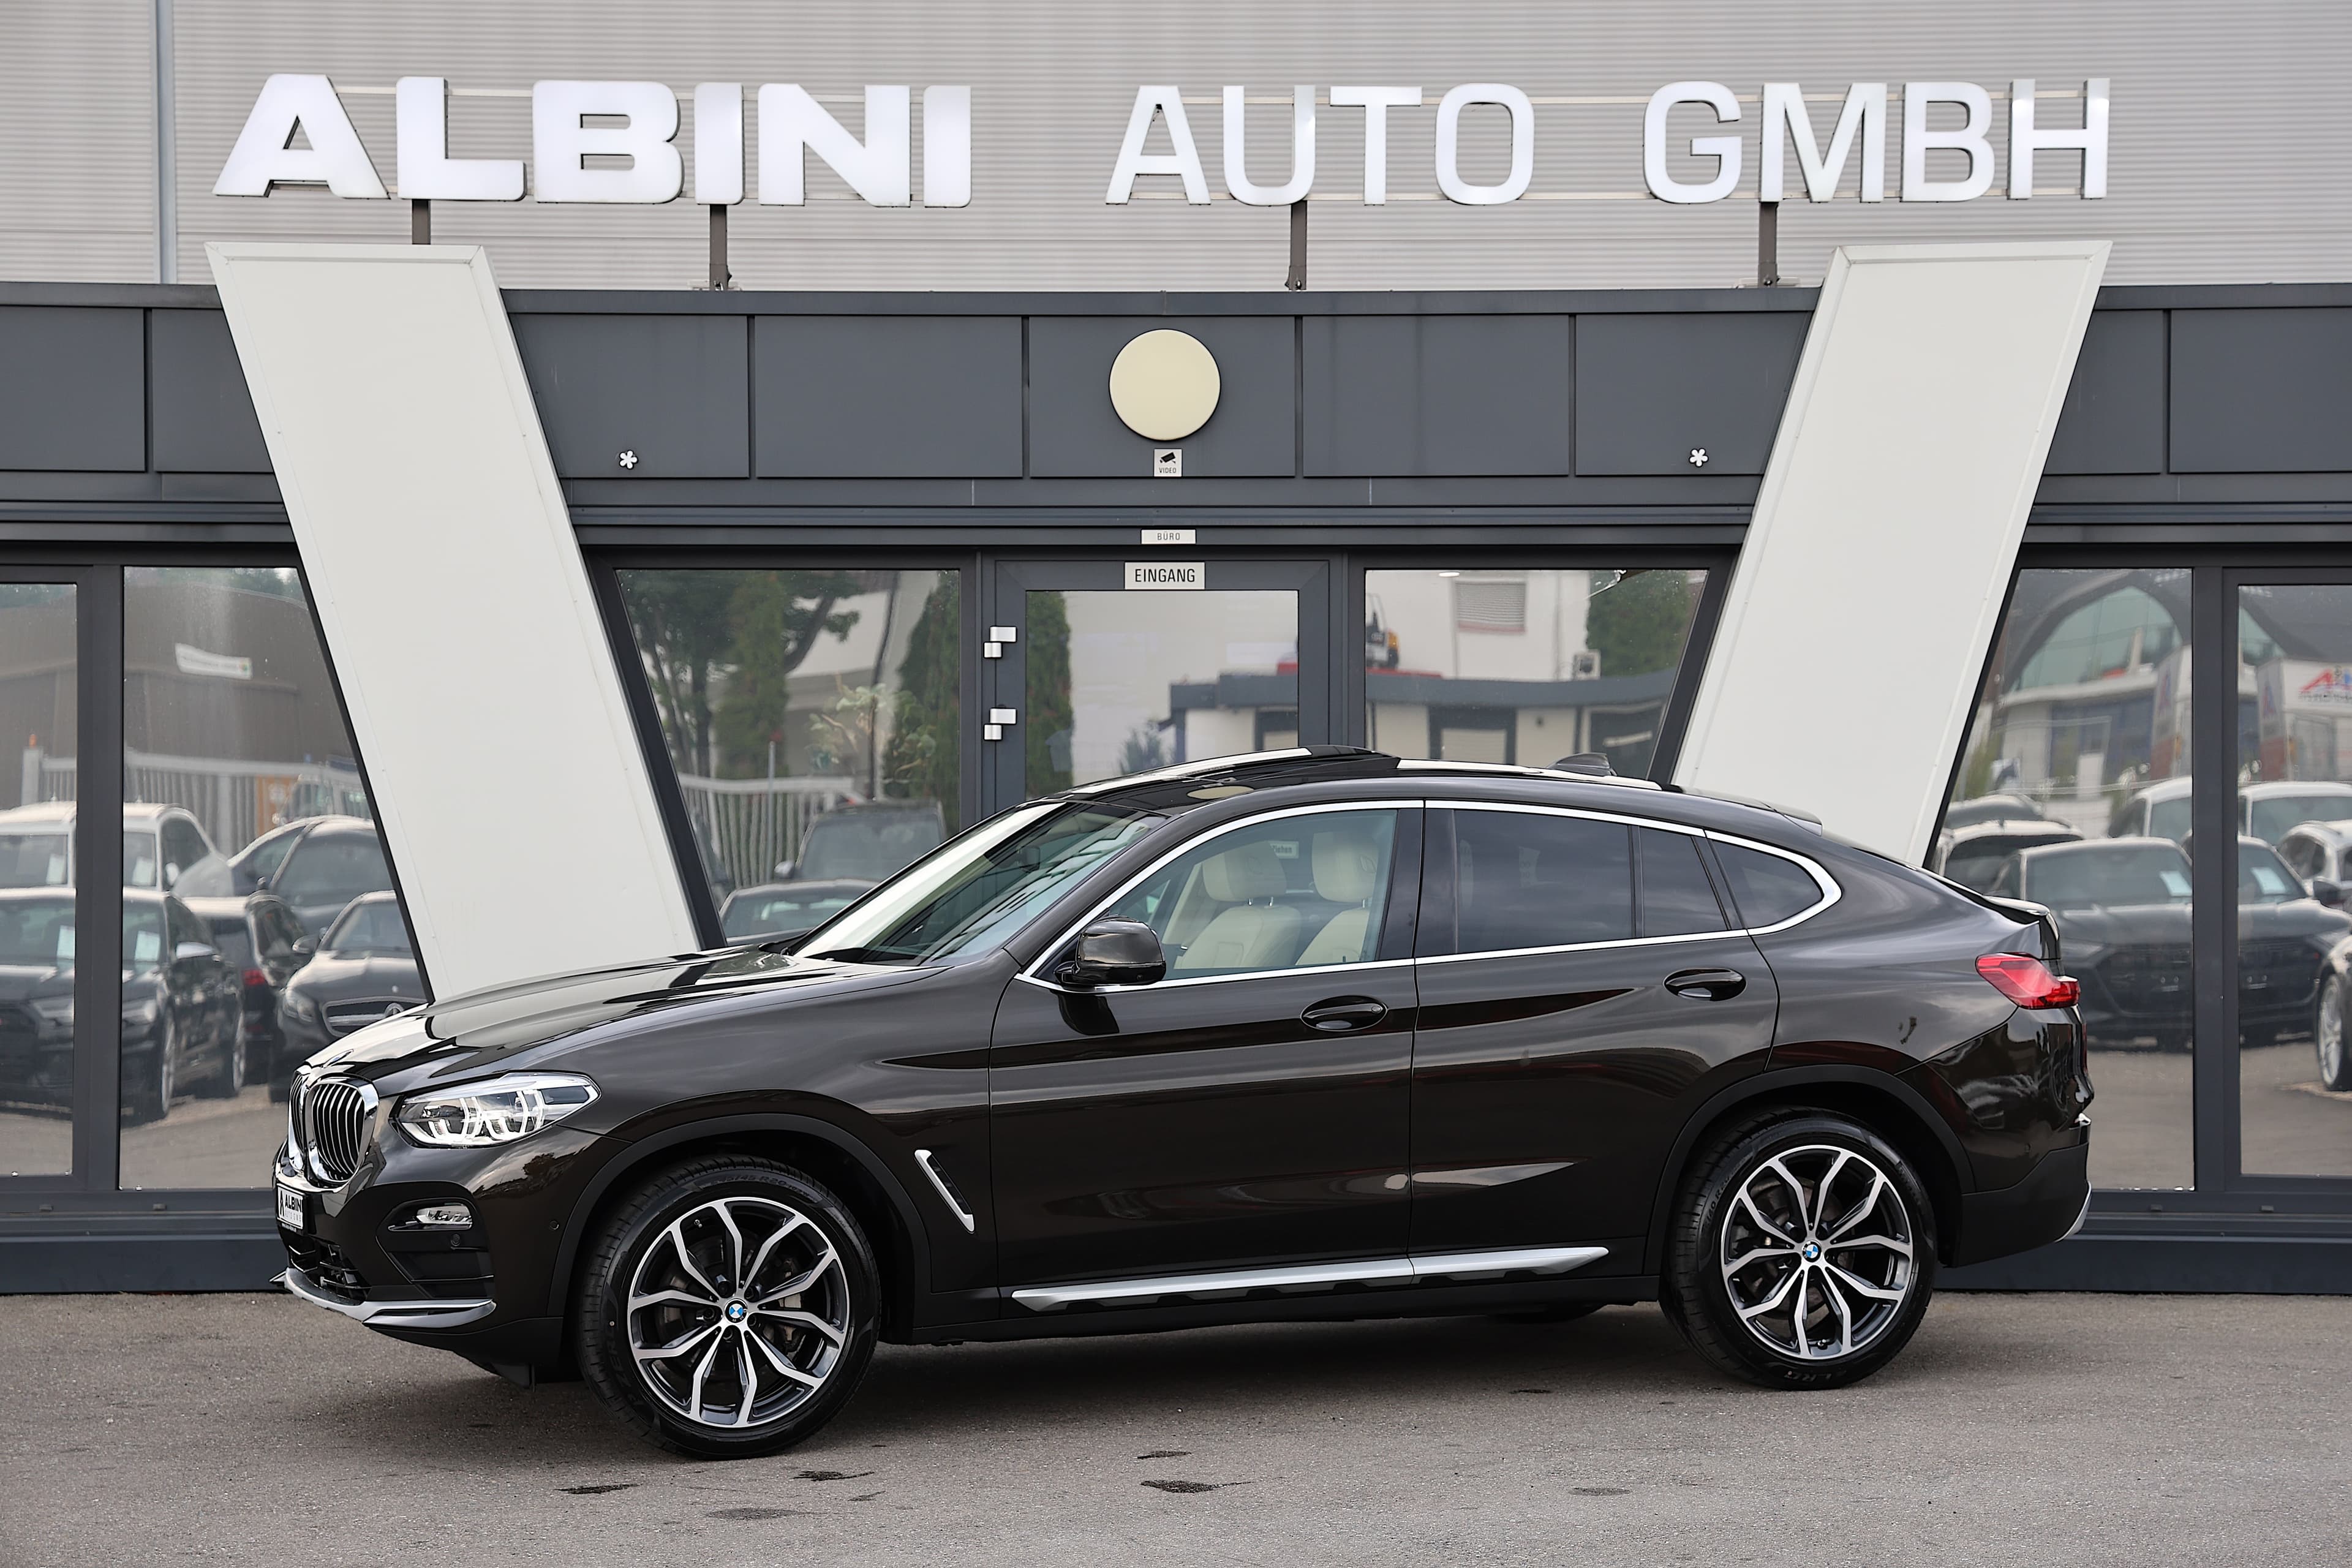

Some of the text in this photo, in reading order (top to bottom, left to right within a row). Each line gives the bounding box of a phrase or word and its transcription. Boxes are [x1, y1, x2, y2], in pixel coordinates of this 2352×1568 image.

[212, 73, 2111, 208] ALBINI AUTO GMBH
[1157, 531, 1181, 540] BÜRO
[1134, 568, 1196, 582] EINGANG
